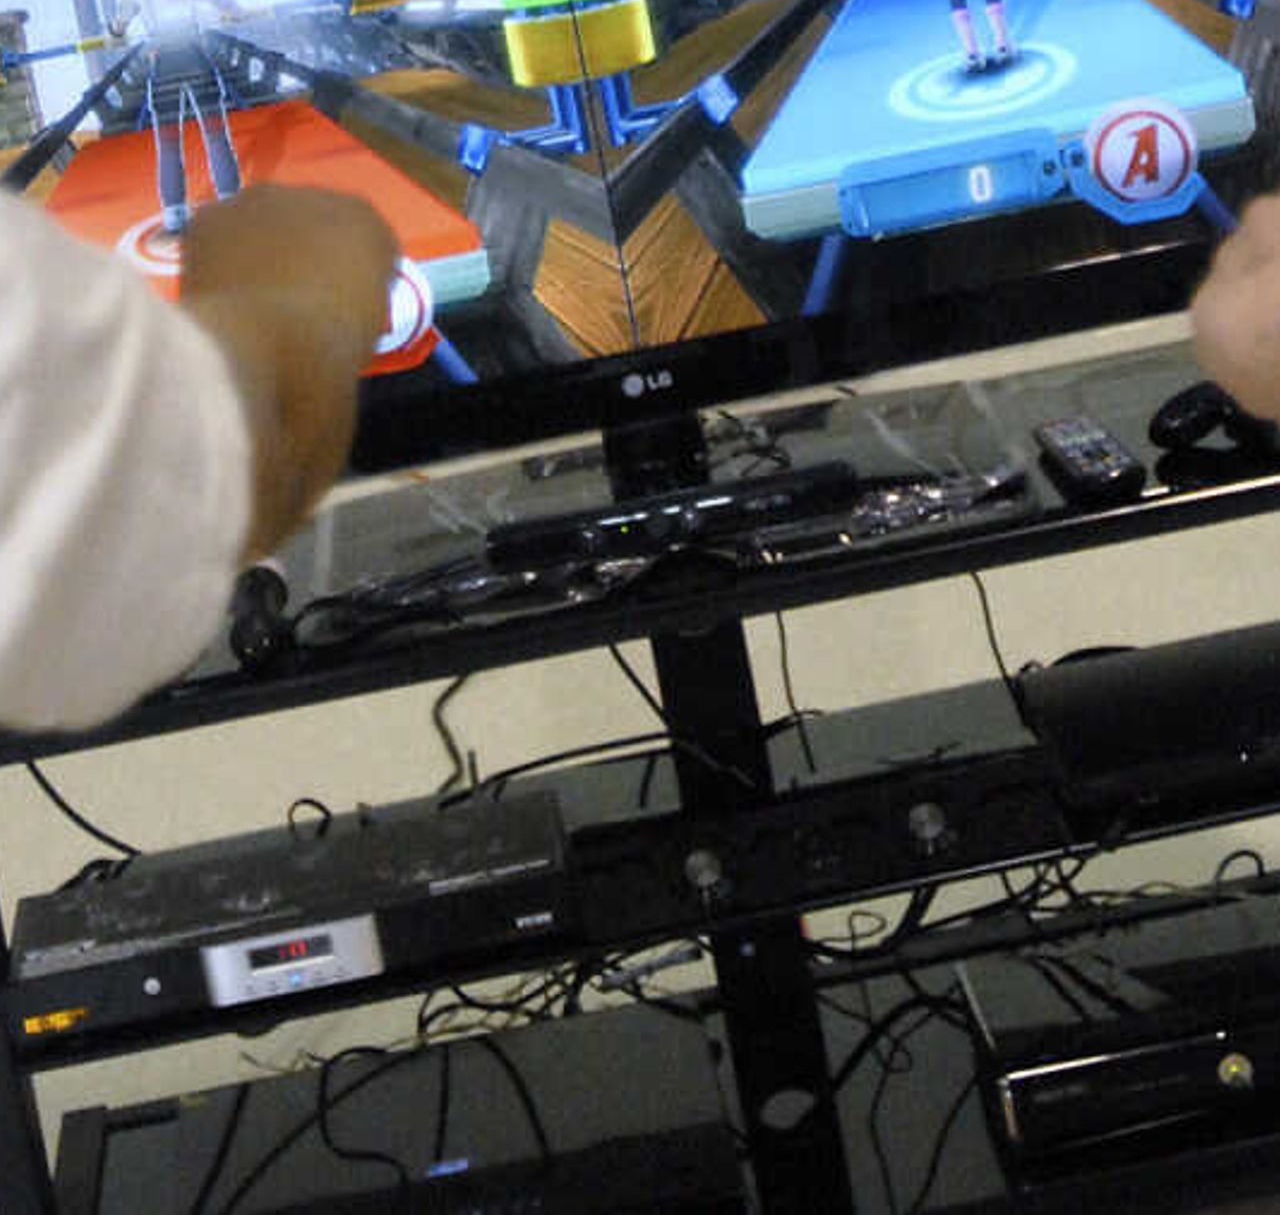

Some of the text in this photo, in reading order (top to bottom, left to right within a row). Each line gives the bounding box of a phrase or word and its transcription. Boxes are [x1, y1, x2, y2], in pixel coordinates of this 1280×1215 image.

[1122, 123, 1160, 189] A
[969, 165, 993, 203] 0
[646, 370, 673, 390] LG
